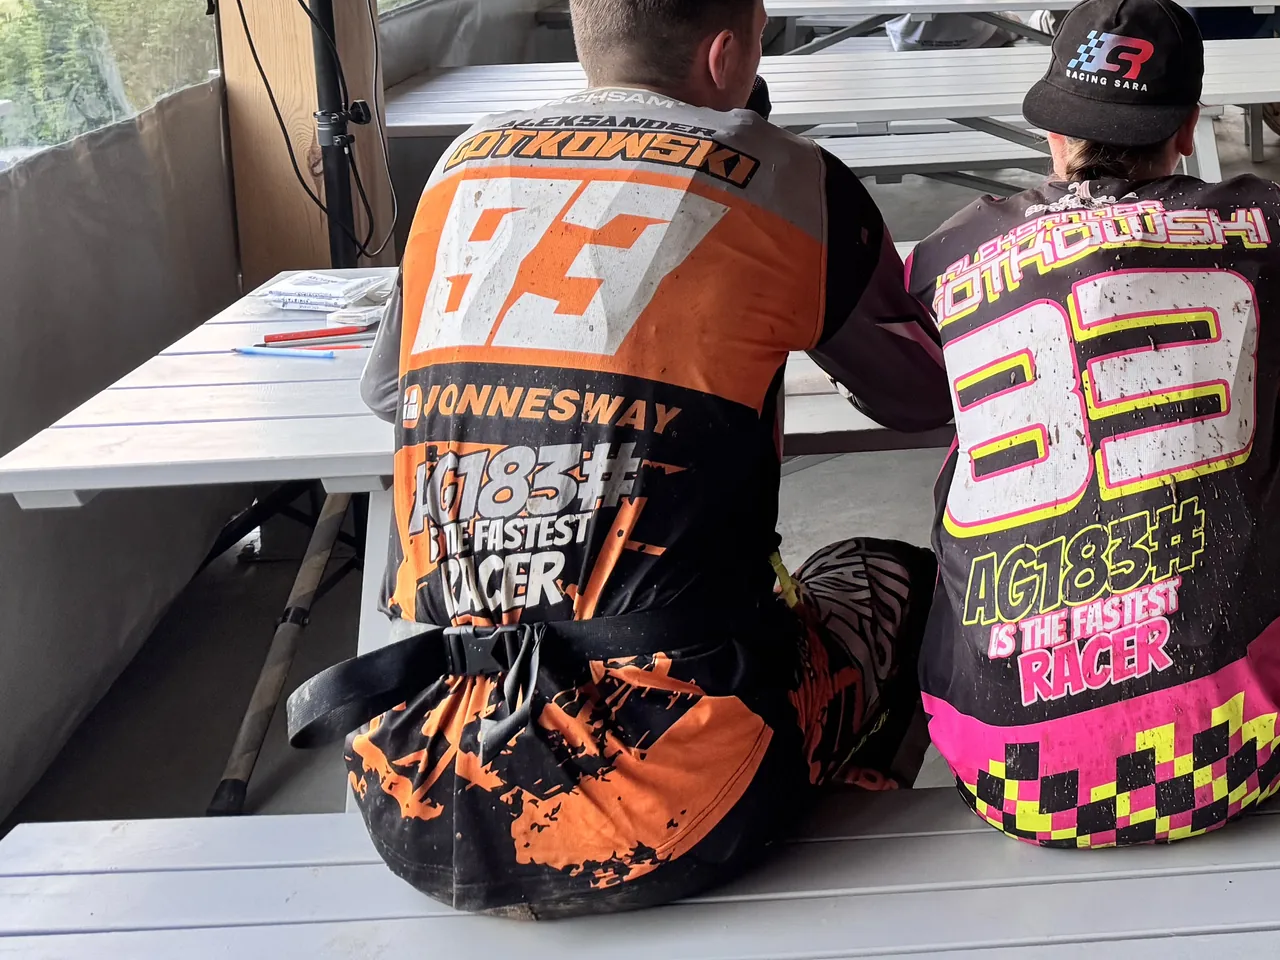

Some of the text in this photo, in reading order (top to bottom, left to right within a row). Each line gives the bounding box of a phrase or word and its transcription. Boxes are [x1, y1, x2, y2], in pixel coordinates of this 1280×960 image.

[1066, 69, 1148, 92] RACING SARA
[424, 383, 682, 434] JONNESWAY
[474, 511, 593, 552] FASTEST
[962, 495, 1205, 626] AG183#
[441, 550, 566, 620] RACER
[988, 576, 1182, 659] IS THE FASTEST
[1017, 616, 1173, 707] RACER
